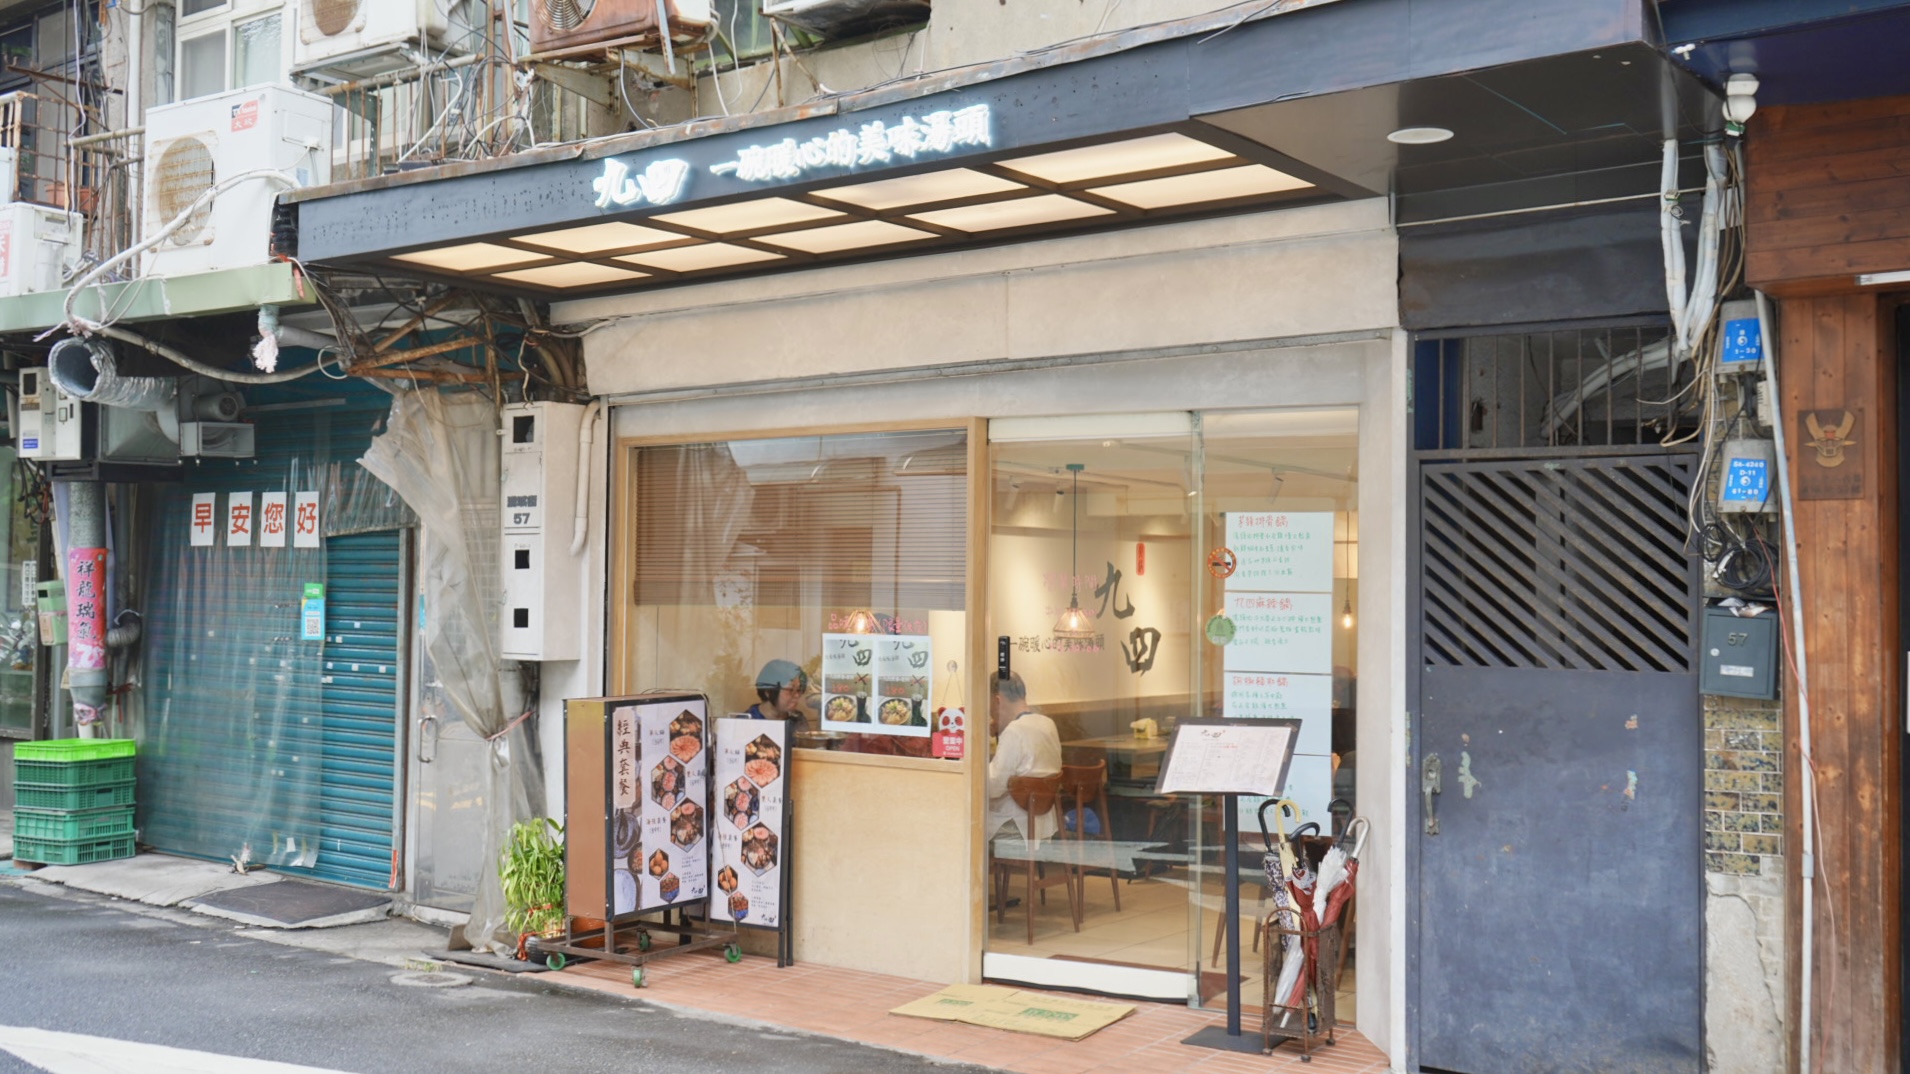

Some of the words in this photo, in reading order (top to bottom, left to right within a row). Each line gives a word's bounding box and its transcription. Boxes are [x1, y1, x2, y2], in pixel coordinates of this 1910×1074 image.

[593, 158, 688, 207] 九四
[194, 502, 317, 534] 早安您好
[513, 513, 530, 524] 57
[1094, 561, 1162, 677] 九四
[1728, 633, 1748, 646] 57
[617, 719, 631, 796] 經典套餐
